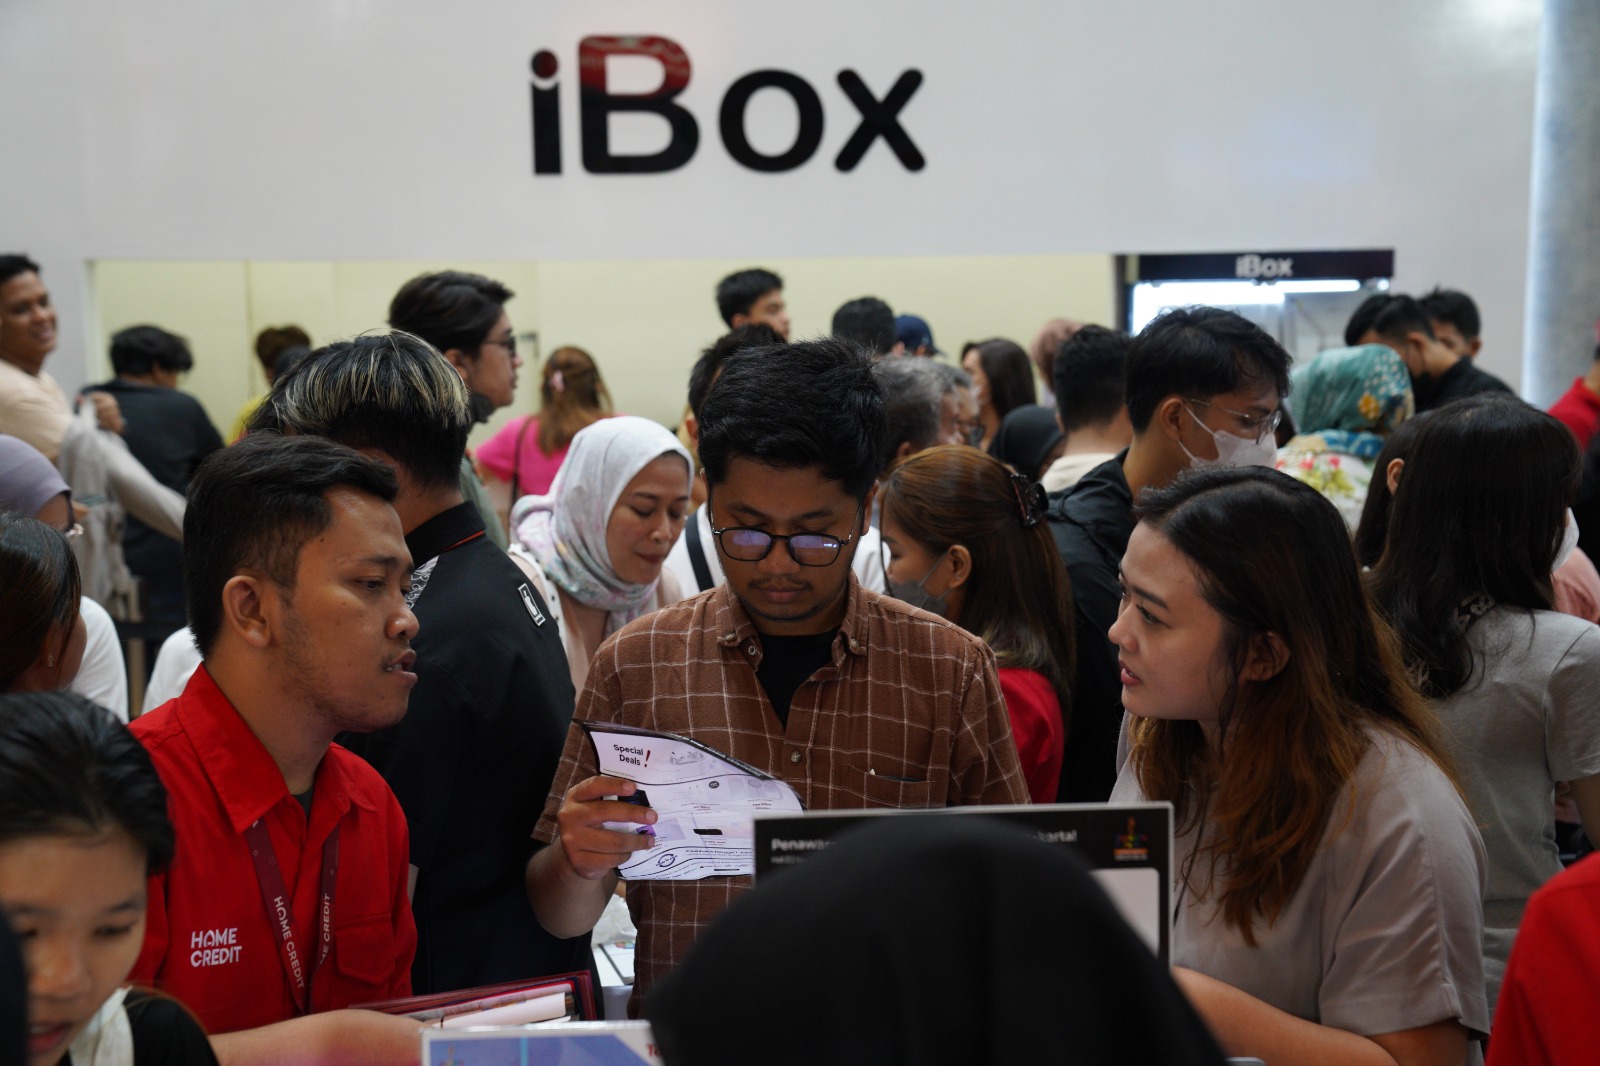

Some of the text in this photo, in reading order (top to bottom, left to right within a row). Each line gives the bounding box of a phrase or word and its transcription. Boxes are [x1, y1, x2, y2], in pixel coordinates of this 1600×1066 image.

[530, 34, 925, 176] iBox
[1236, 254, 1294, 278] iBox
[613, 744, 644, 756] Special
[323, 893, 331, 942] CREDIT
[190, 928, 238, 949] HOME
[274, 896, 304, 988] HOME CREDIT
[190, 946, 243, 968] CREDIT
